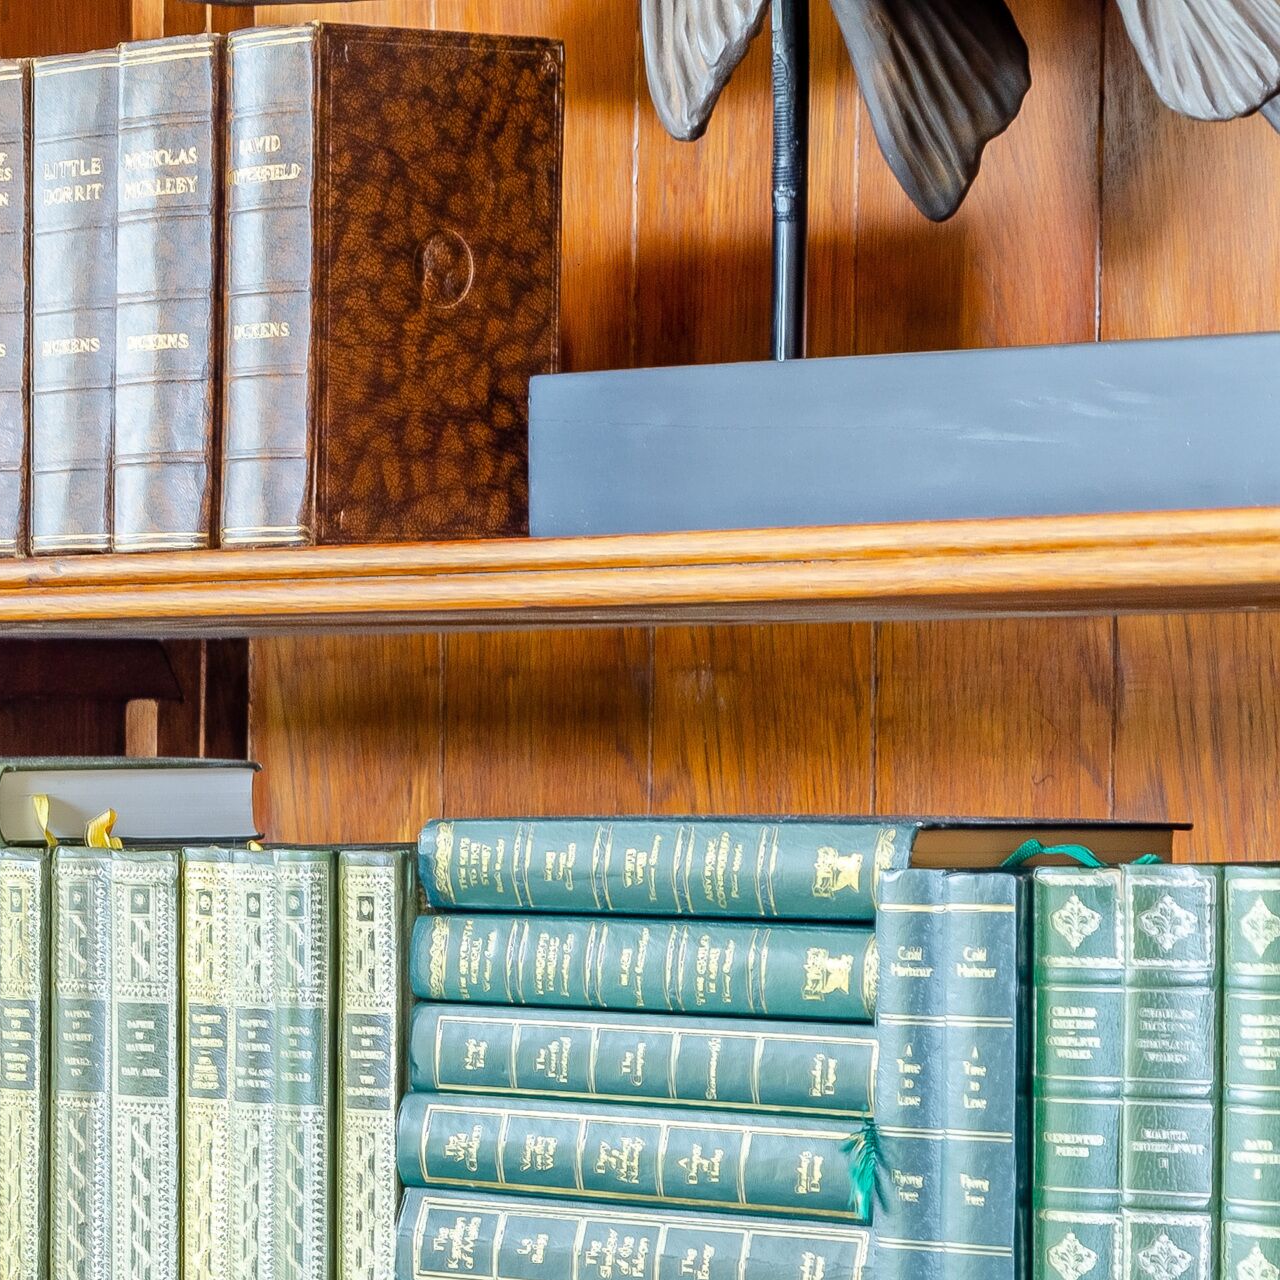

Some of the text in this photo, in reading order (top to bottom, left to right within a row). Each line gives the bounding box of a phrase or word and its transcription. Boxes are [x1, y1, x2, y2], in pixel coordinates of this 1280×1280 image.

[43, 158, 103, 181] LITTLE
[123, 147, 198, 171] NICHOLAS
[43, 183, 104, 205] DORRIT
[123, 176, 198, 199] NICKLEBY
[126, 332, 189, 351] DICKENS
[233, 321, 290, 340] DICKENS
[42, 337, 101, 357] DICKENS
[896, 945, 924, 962] Cold
[962, 946, 988, 963] Cold
[533, 1048, 546, 1071] The
[546, 1040, 560, 1078] Fourth
[557, 1036, 572, 1083] Protocol
[621, 1051, 634, 1075] The
[809, 1053, 826, 1097] Reader's
[822, 1057, 837, 1095] Digest
[466, 1124, 484, 1172] Children
[433, 1227, 450, 1252] The
[585, 1239, 603, 1268] The
[598, 1228, 619, 1280] Shadow
[630, 1236, 650, 1279] Falcon
[679, 1247, 698, 1276] The
